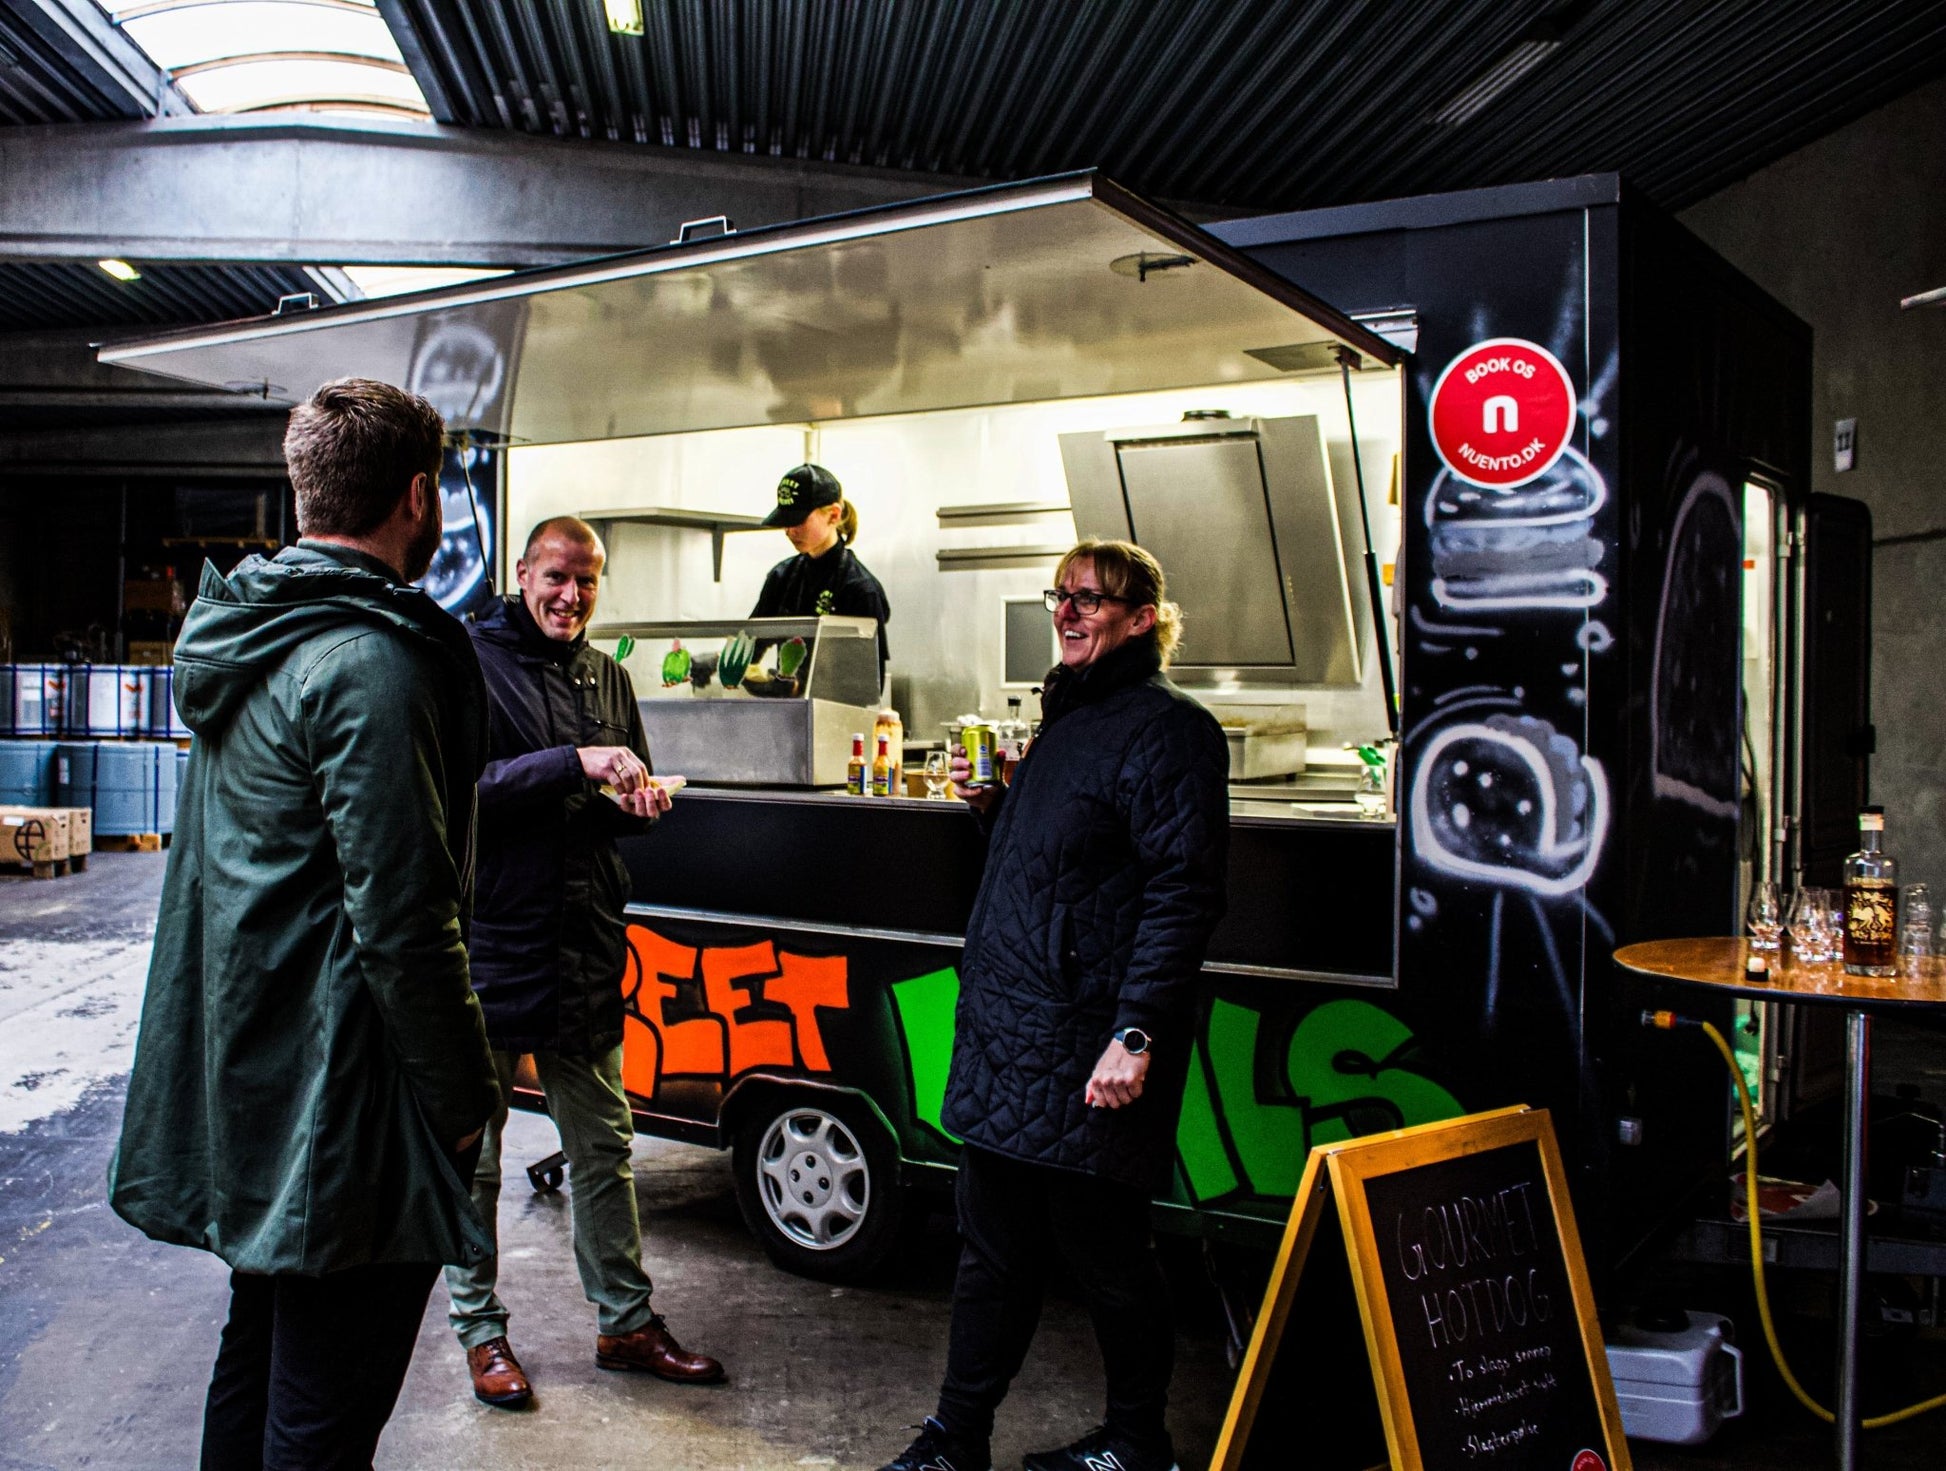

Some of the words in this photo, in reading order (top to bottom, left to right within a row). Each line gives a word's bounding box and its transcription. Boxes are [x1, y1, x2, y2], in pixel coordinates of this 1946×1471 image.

[1464, 357, 1511, 385] BOOK
[1512, 359, 1536, 379] OS
[1458, 437, 1546, 471] NUENTO.DK
[1397, 1182, 1540, 1281] GOURMET
[1421, 1268, 1552, 1349] HOTDOG
[1479, 1354, 1511, 1377] slags
